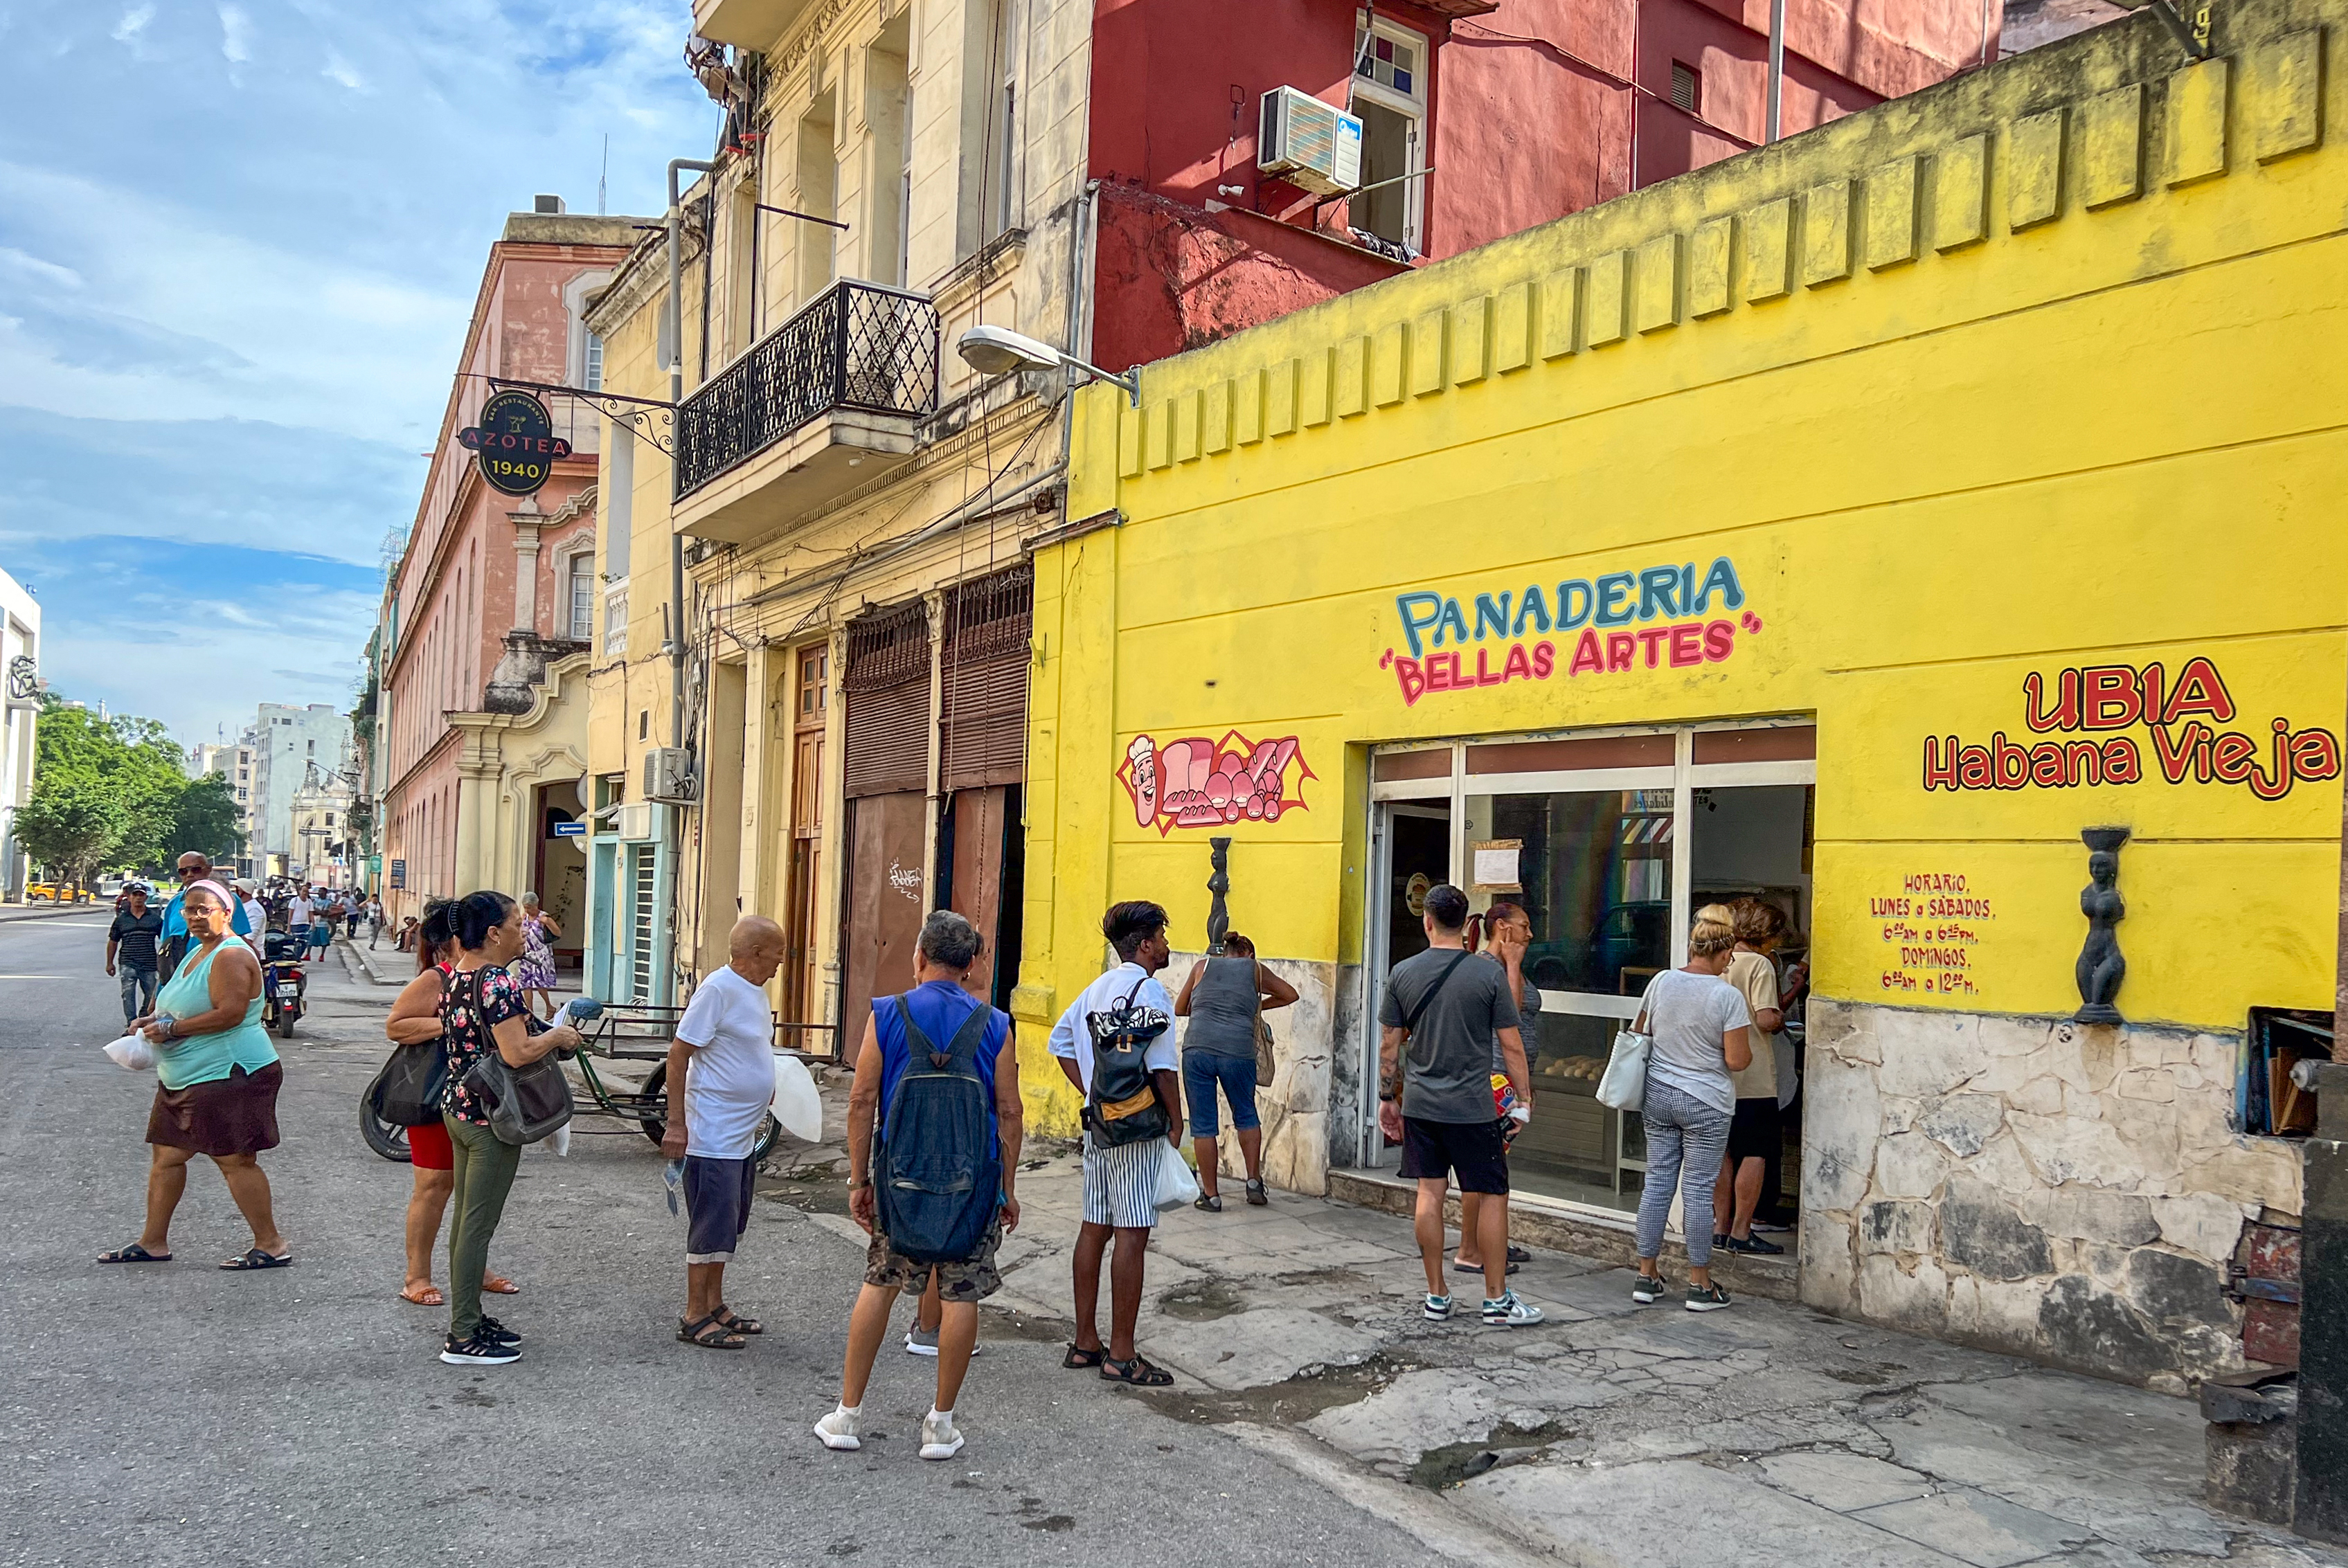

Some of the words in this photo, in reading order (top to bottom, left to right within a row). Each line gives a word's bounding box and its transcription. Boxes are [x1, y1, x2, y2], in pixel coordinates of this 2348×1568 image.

[488, 397, 544, 425] BAR-RESTAURANTE
[465, 431, 566, 456] AZOTEA
[492, 459, 539, 478] 1940
[1396, 556, 1745, 660] PANADERIA
[1924, 731, 2143, 792] Habana
[2150, 718, 2340, 801] Vieja
[1870, 897, 1910, 918] LUNES
